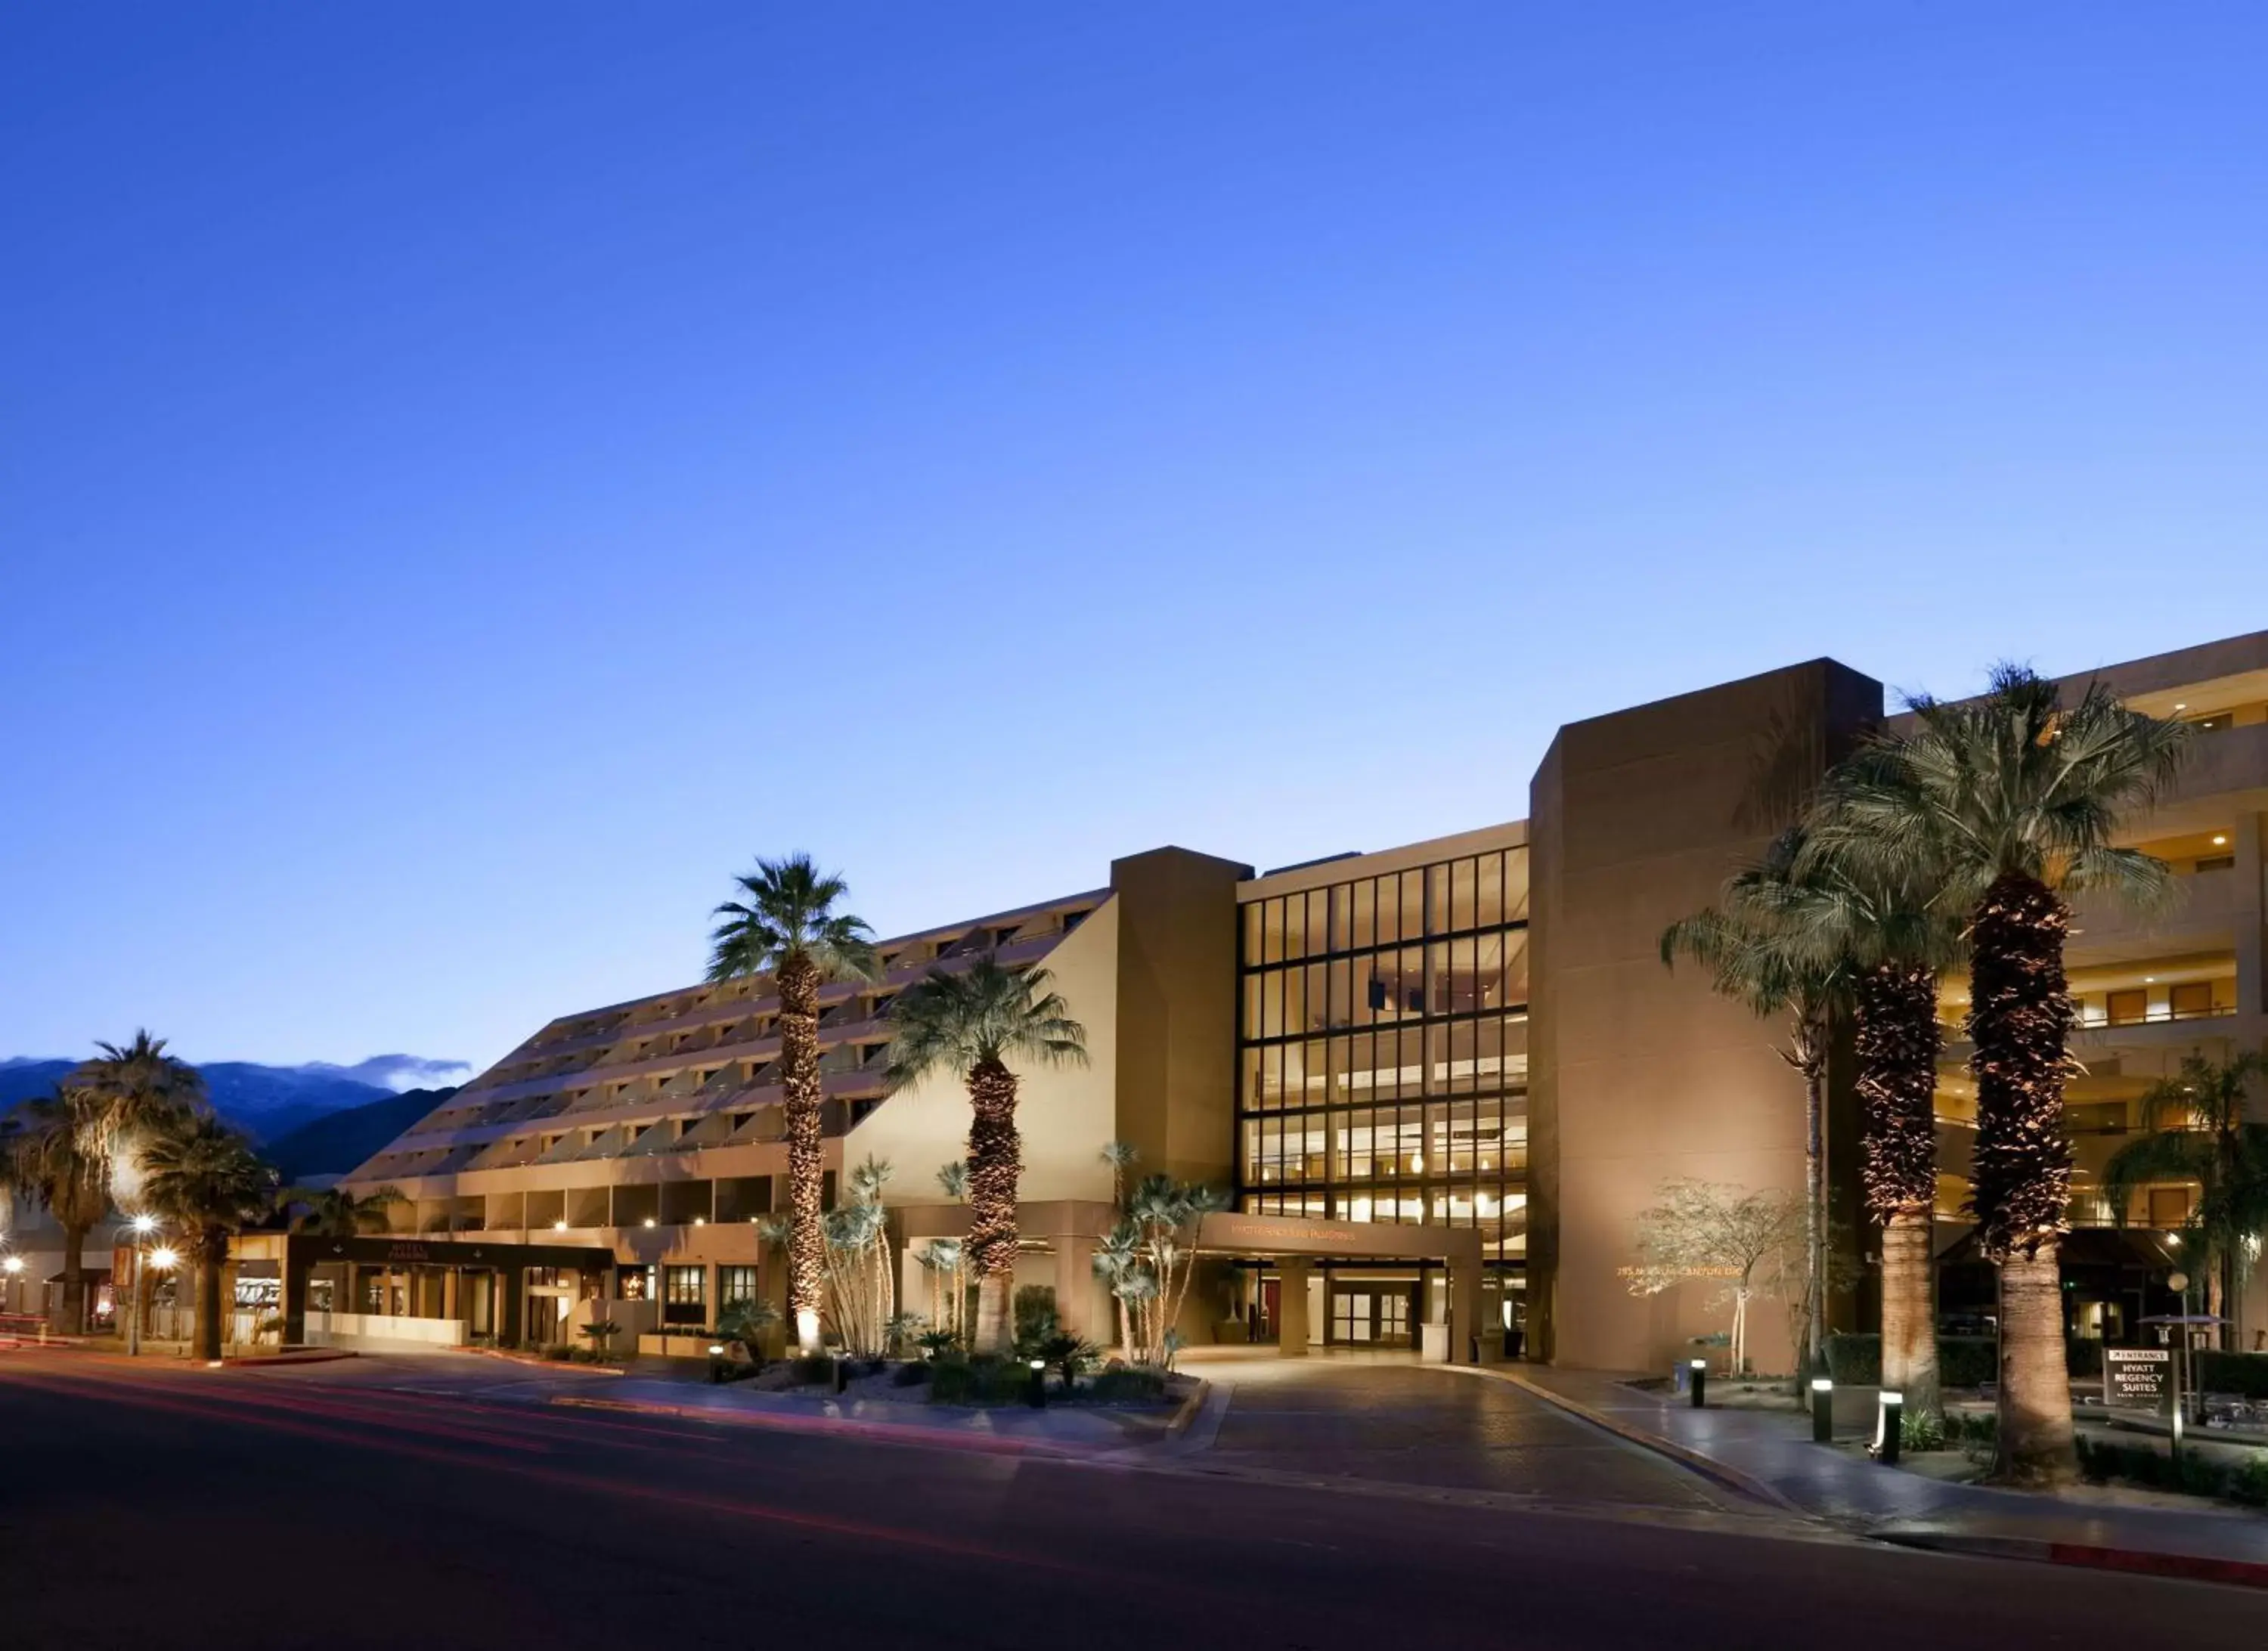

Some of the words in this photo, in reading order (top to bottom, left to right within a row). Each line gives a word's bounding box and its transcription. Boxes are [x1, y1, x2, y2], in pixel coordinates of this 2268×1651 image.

[2121, 1351, 2165, 1360] ENTRANCE
[2122, 1364, 2155, 1372] HYATT
[2115, 1374, 2164, 1383] REGENCY
[2122, 1383, 2158, 1392] SUITES
